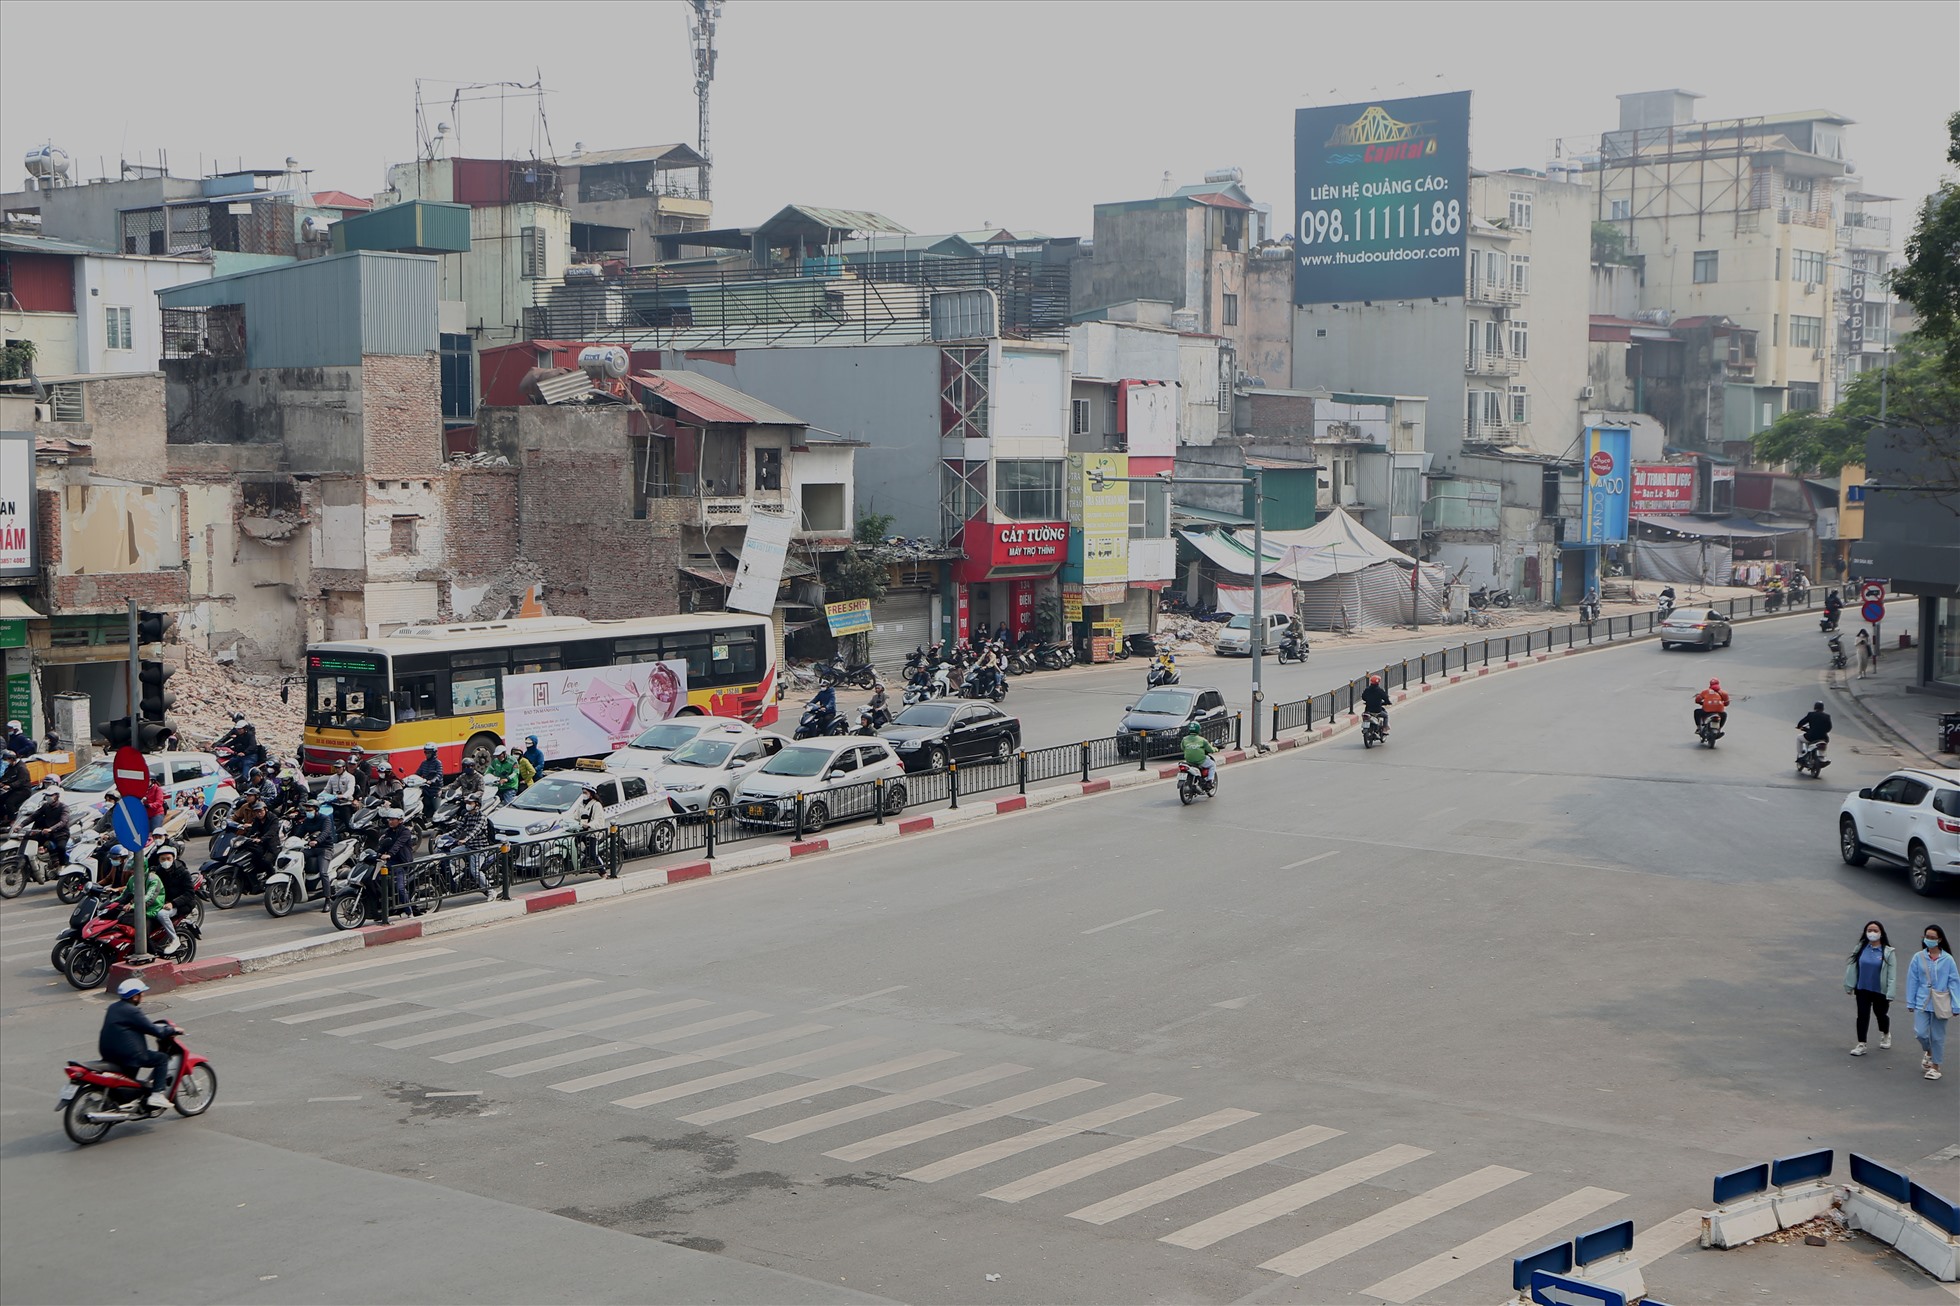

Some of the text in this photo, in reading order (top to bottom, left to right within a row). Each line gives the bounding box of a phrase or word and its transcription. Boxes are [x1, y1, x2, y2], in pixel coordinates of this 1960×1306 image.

[1364, 140, 1425, 164] Capital
[1310, 175, 1448, 201] LIÊN HỆ QUẢNG CÁO:
[1300, 199, 1461, 245] 098.11111.88
[1301, 246, 1460, 266] www.thudooutdoor.com
[1852, 273, 1865, 342] HOTEL
[1001, 524, 1066, 543] CÁT TƯỜNG
[1009, 545, 1022, 556] MÁY
[1023, 545, 1037, 558] TRỢ
[827, 600, 868, 615] FREE SHIP
